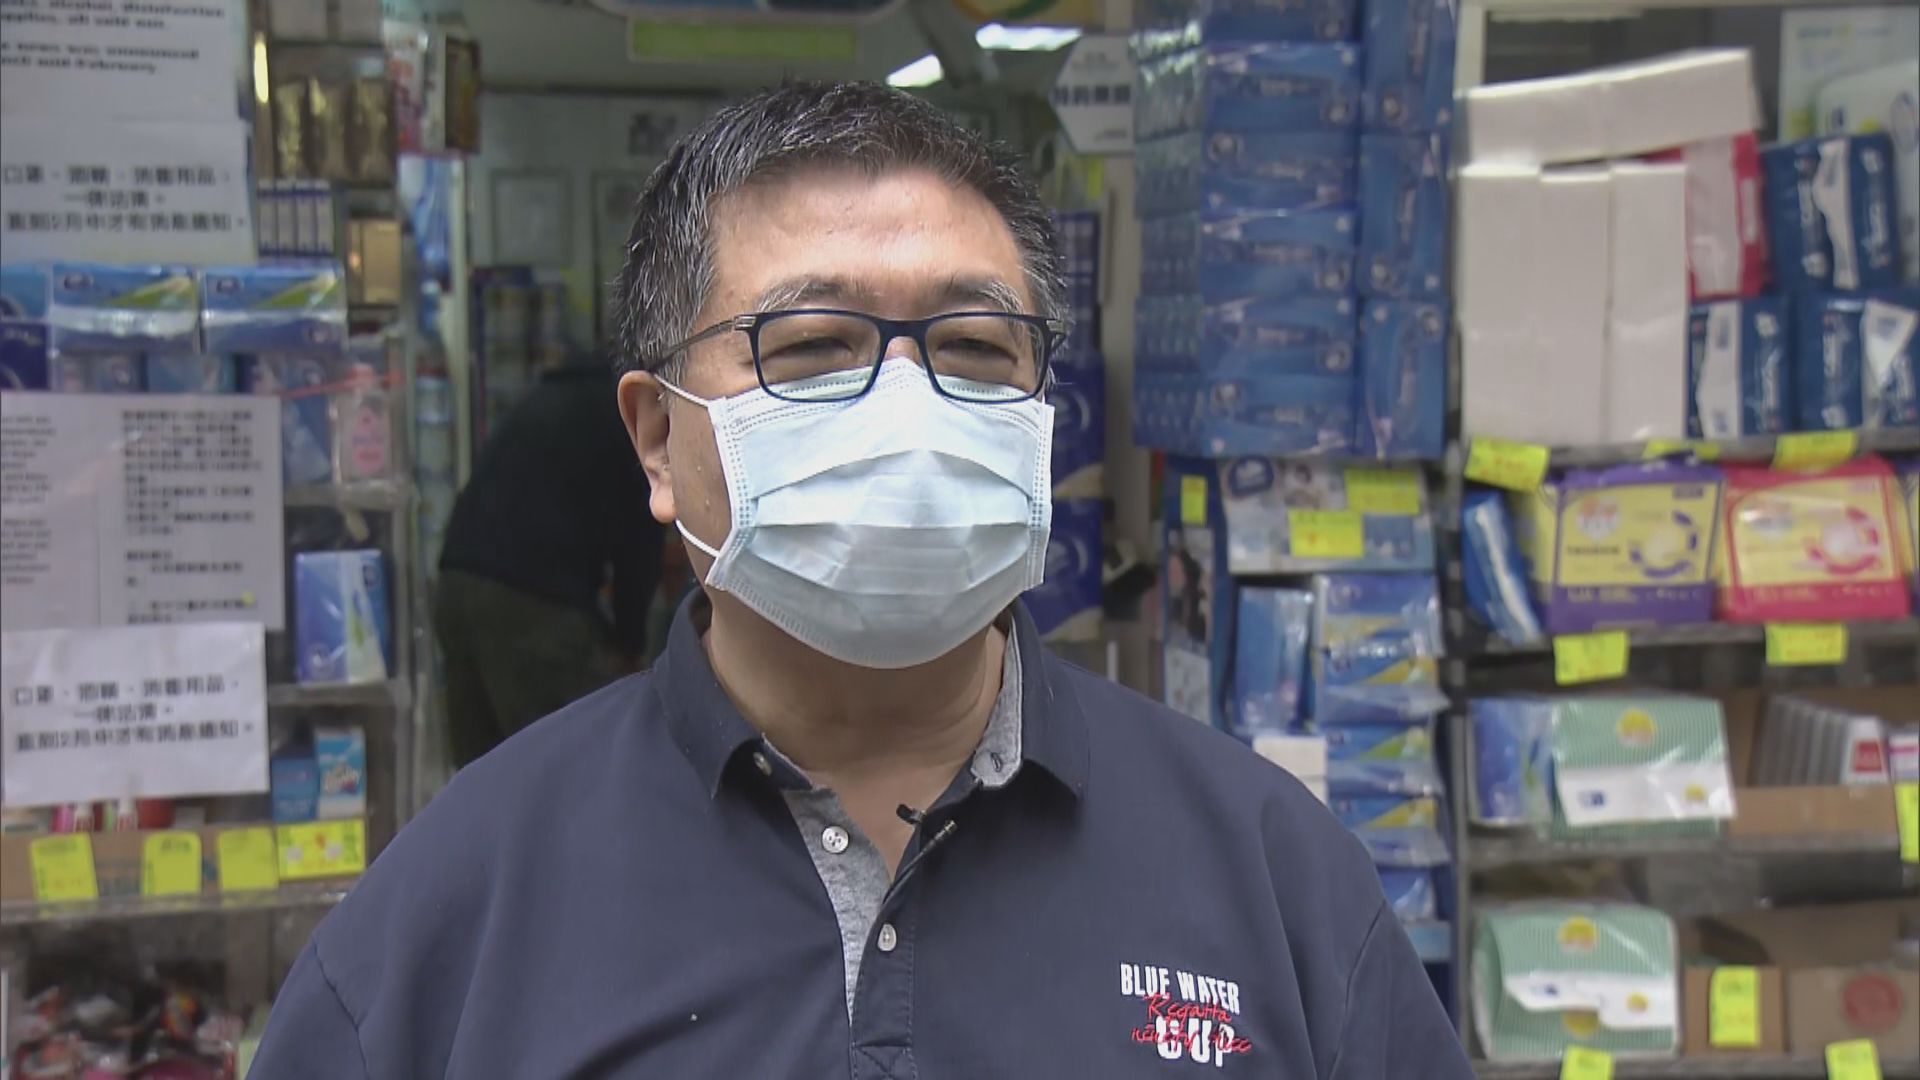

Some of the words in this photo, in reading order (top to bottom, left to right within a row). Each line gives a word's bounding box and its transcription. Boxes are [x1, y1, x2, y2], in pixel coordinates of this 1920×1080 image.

[1120, 962, 1170, 999] BLUE
[1176, 970, 1240, 1015] WATER
[1155, 1015, 1235, 1068] CUP
